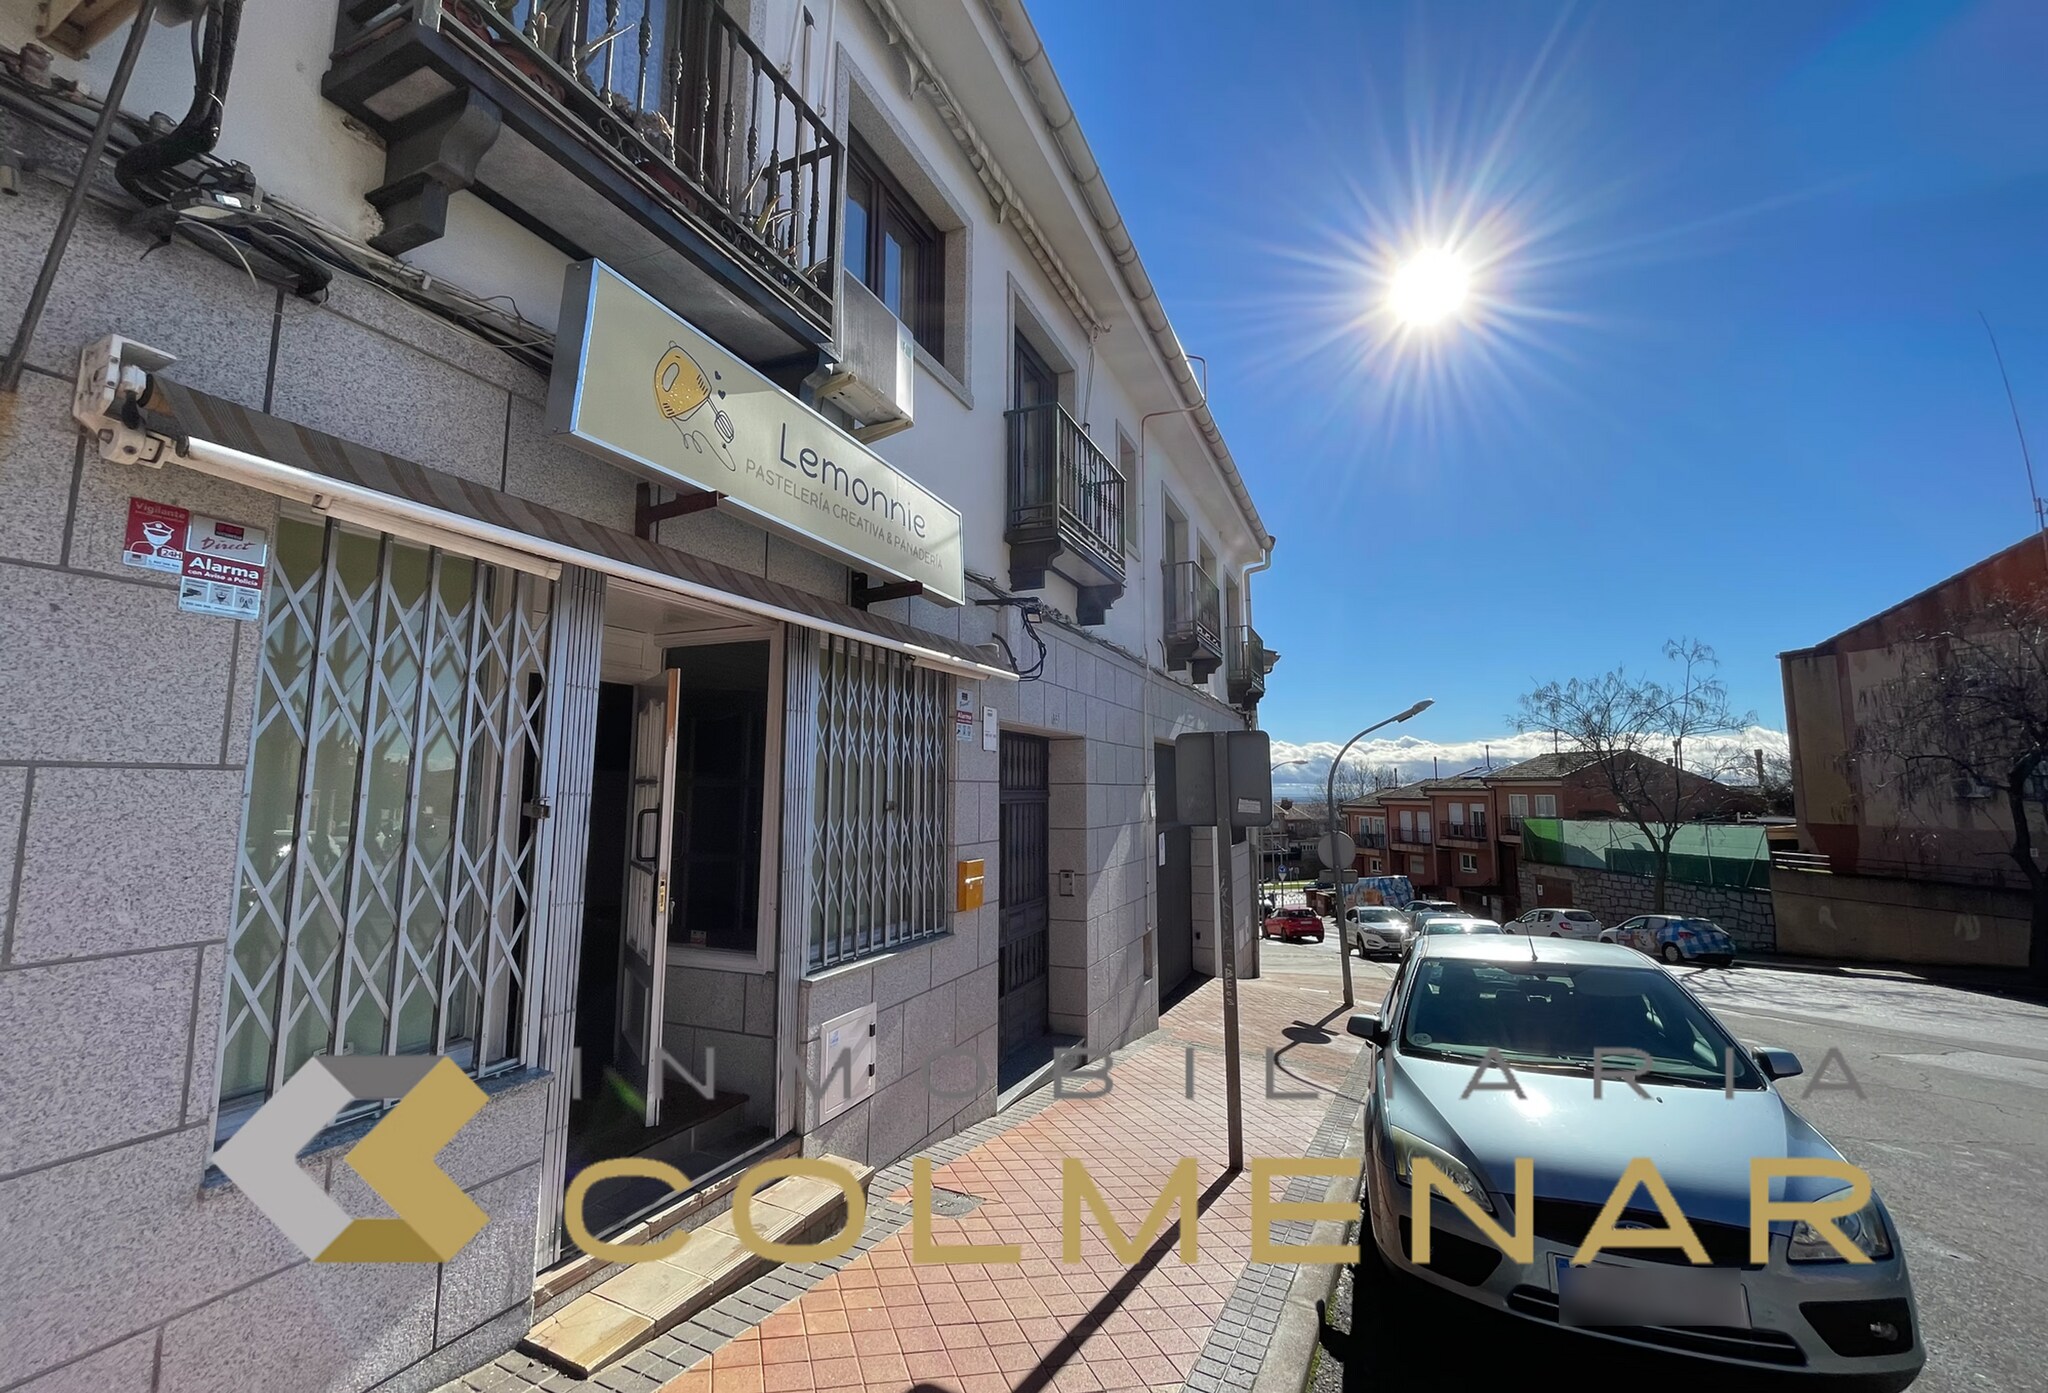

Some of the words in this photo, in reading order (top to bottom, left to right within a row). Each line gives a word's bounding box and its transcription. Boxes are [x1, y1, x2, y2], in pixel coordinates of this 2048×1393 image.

[780, 422, 926, 538] Lemonnie
[135, 501, 186, 519] Vigilante
[746, 458, 830, 515] PASTELERÍA
[832, 503, 885, 541] CREATIVA
[886, 532, 893, 545] &
[894, 536, 943, 569] PANADERÍA
[201, 537, 256, 551] Direct
[189, 556, 260, 580] Alarma
[204, 571, 226, 581] Aviso
